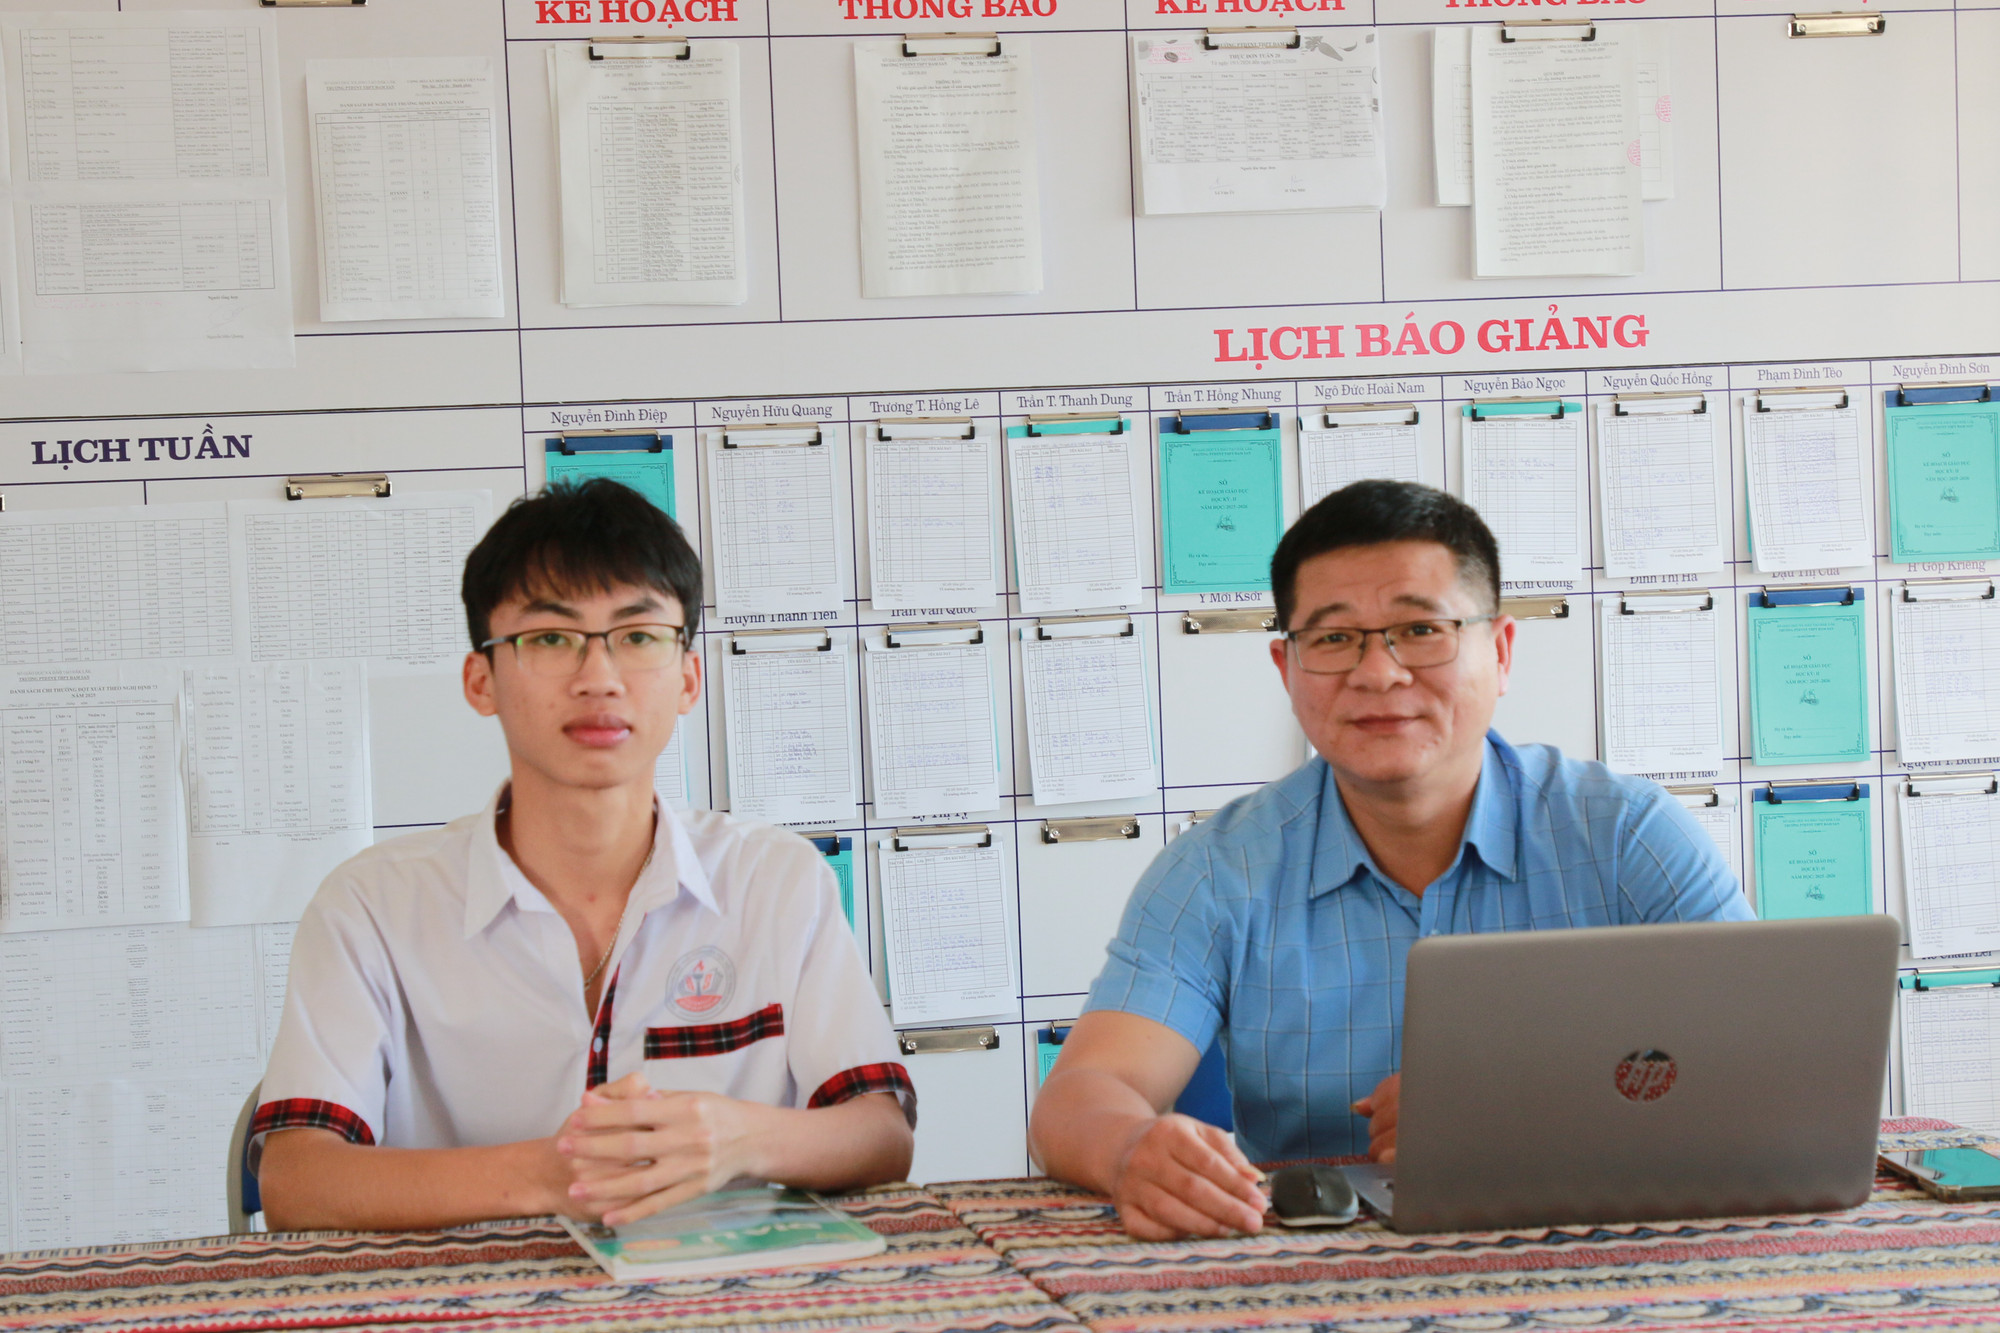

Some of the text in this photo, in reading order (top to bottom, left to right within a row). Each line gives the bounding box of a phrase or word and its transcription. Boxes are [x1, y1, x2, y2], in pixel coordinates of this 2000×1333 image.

[1214, 303, 1649, 371] LỊCH BÁO GIẢNG
[1603, 370, 1713, 388] Nguyễn Quốc Hồng
[1758, 366, 1842, 383] Phạm Đình Tèo
[1892, 362, 1990, 379] Nguyễn Đình Sơn
[1314, 382, 1425, 399] Ngô Đức Hoài Nam
[1464, 376, 1566, 394] Nguyễn Bảo Ngọc
[1016, 393, 1133, 408] Trần T. Thanh Dung
[1164, 387, 1282, 404] Trần T. Hồng Nhung
[712, 404, 832, 421] Nguyễn Hữu Quang
[870, 397, 980, 415] Trương T. Hồng Lê
[551, 407, 668, 427] Nguyễn Đình Điệp
[31, 423, 253, 471] LỊCH TUẦN
[1200, 594, 1206, 603] Y
